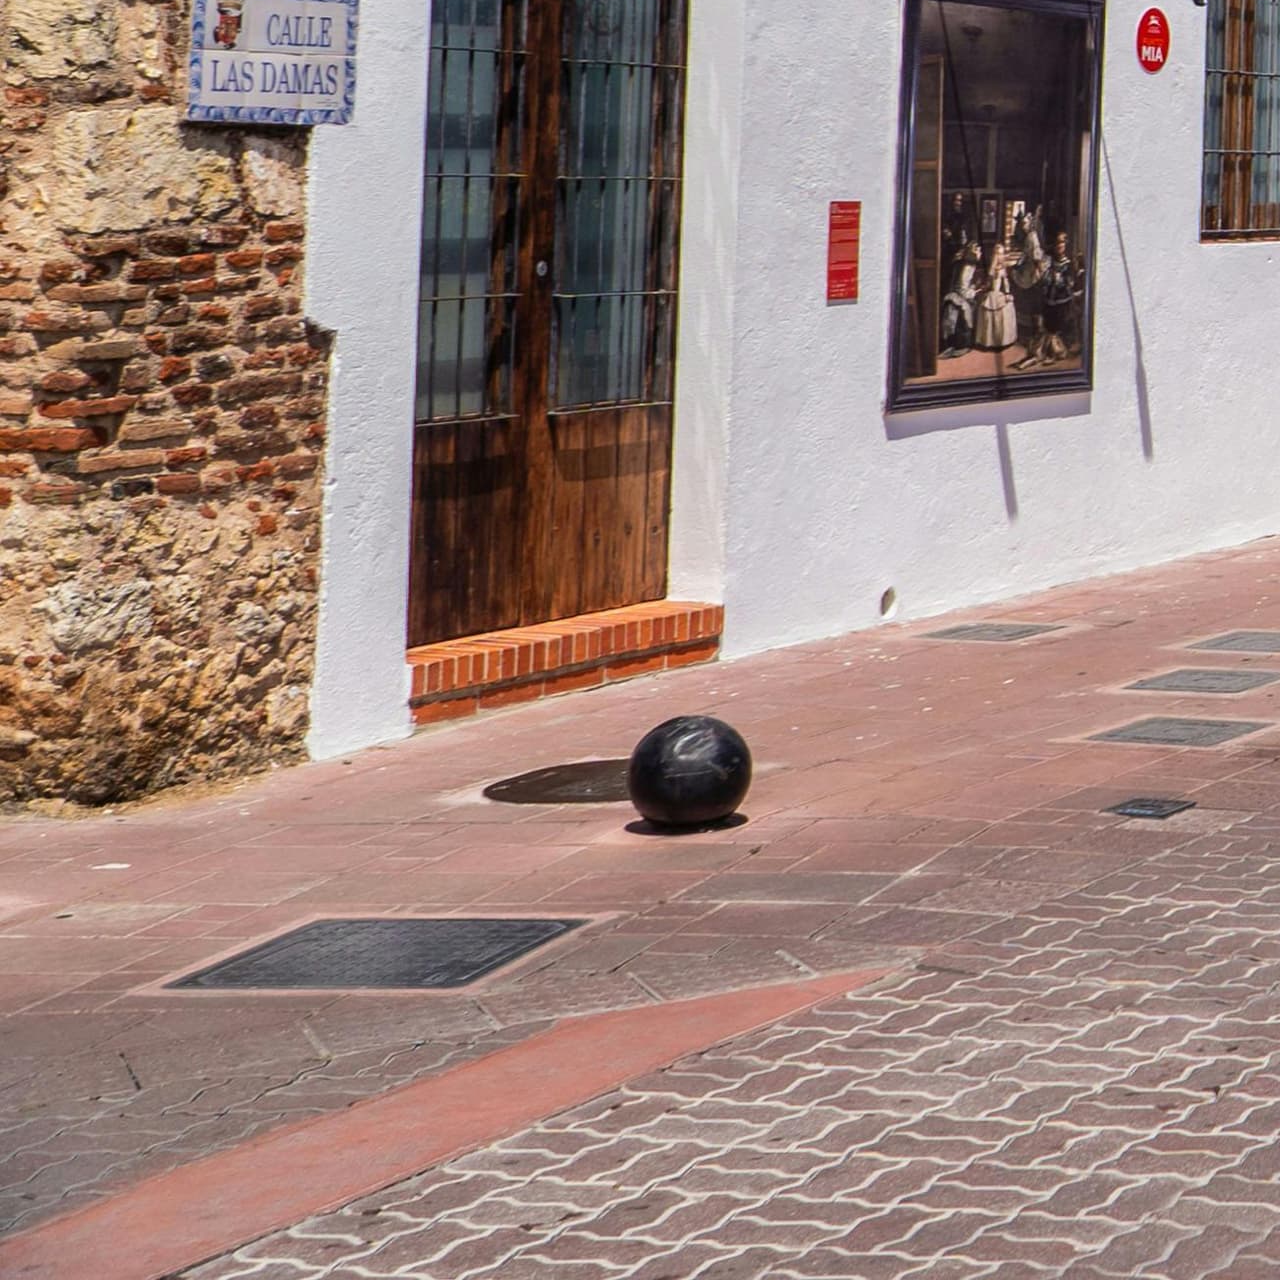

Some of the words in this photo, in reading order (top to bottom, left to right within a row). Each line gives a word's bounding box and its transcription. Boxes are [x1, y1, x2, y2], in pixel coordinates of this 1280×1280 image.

[267, 14, 332, 48] CALLE
[1141, 45, 1164, 63] MIA
[211, 60, 255, 93] LAS
[261, 62, 338, 95] DAMAS
